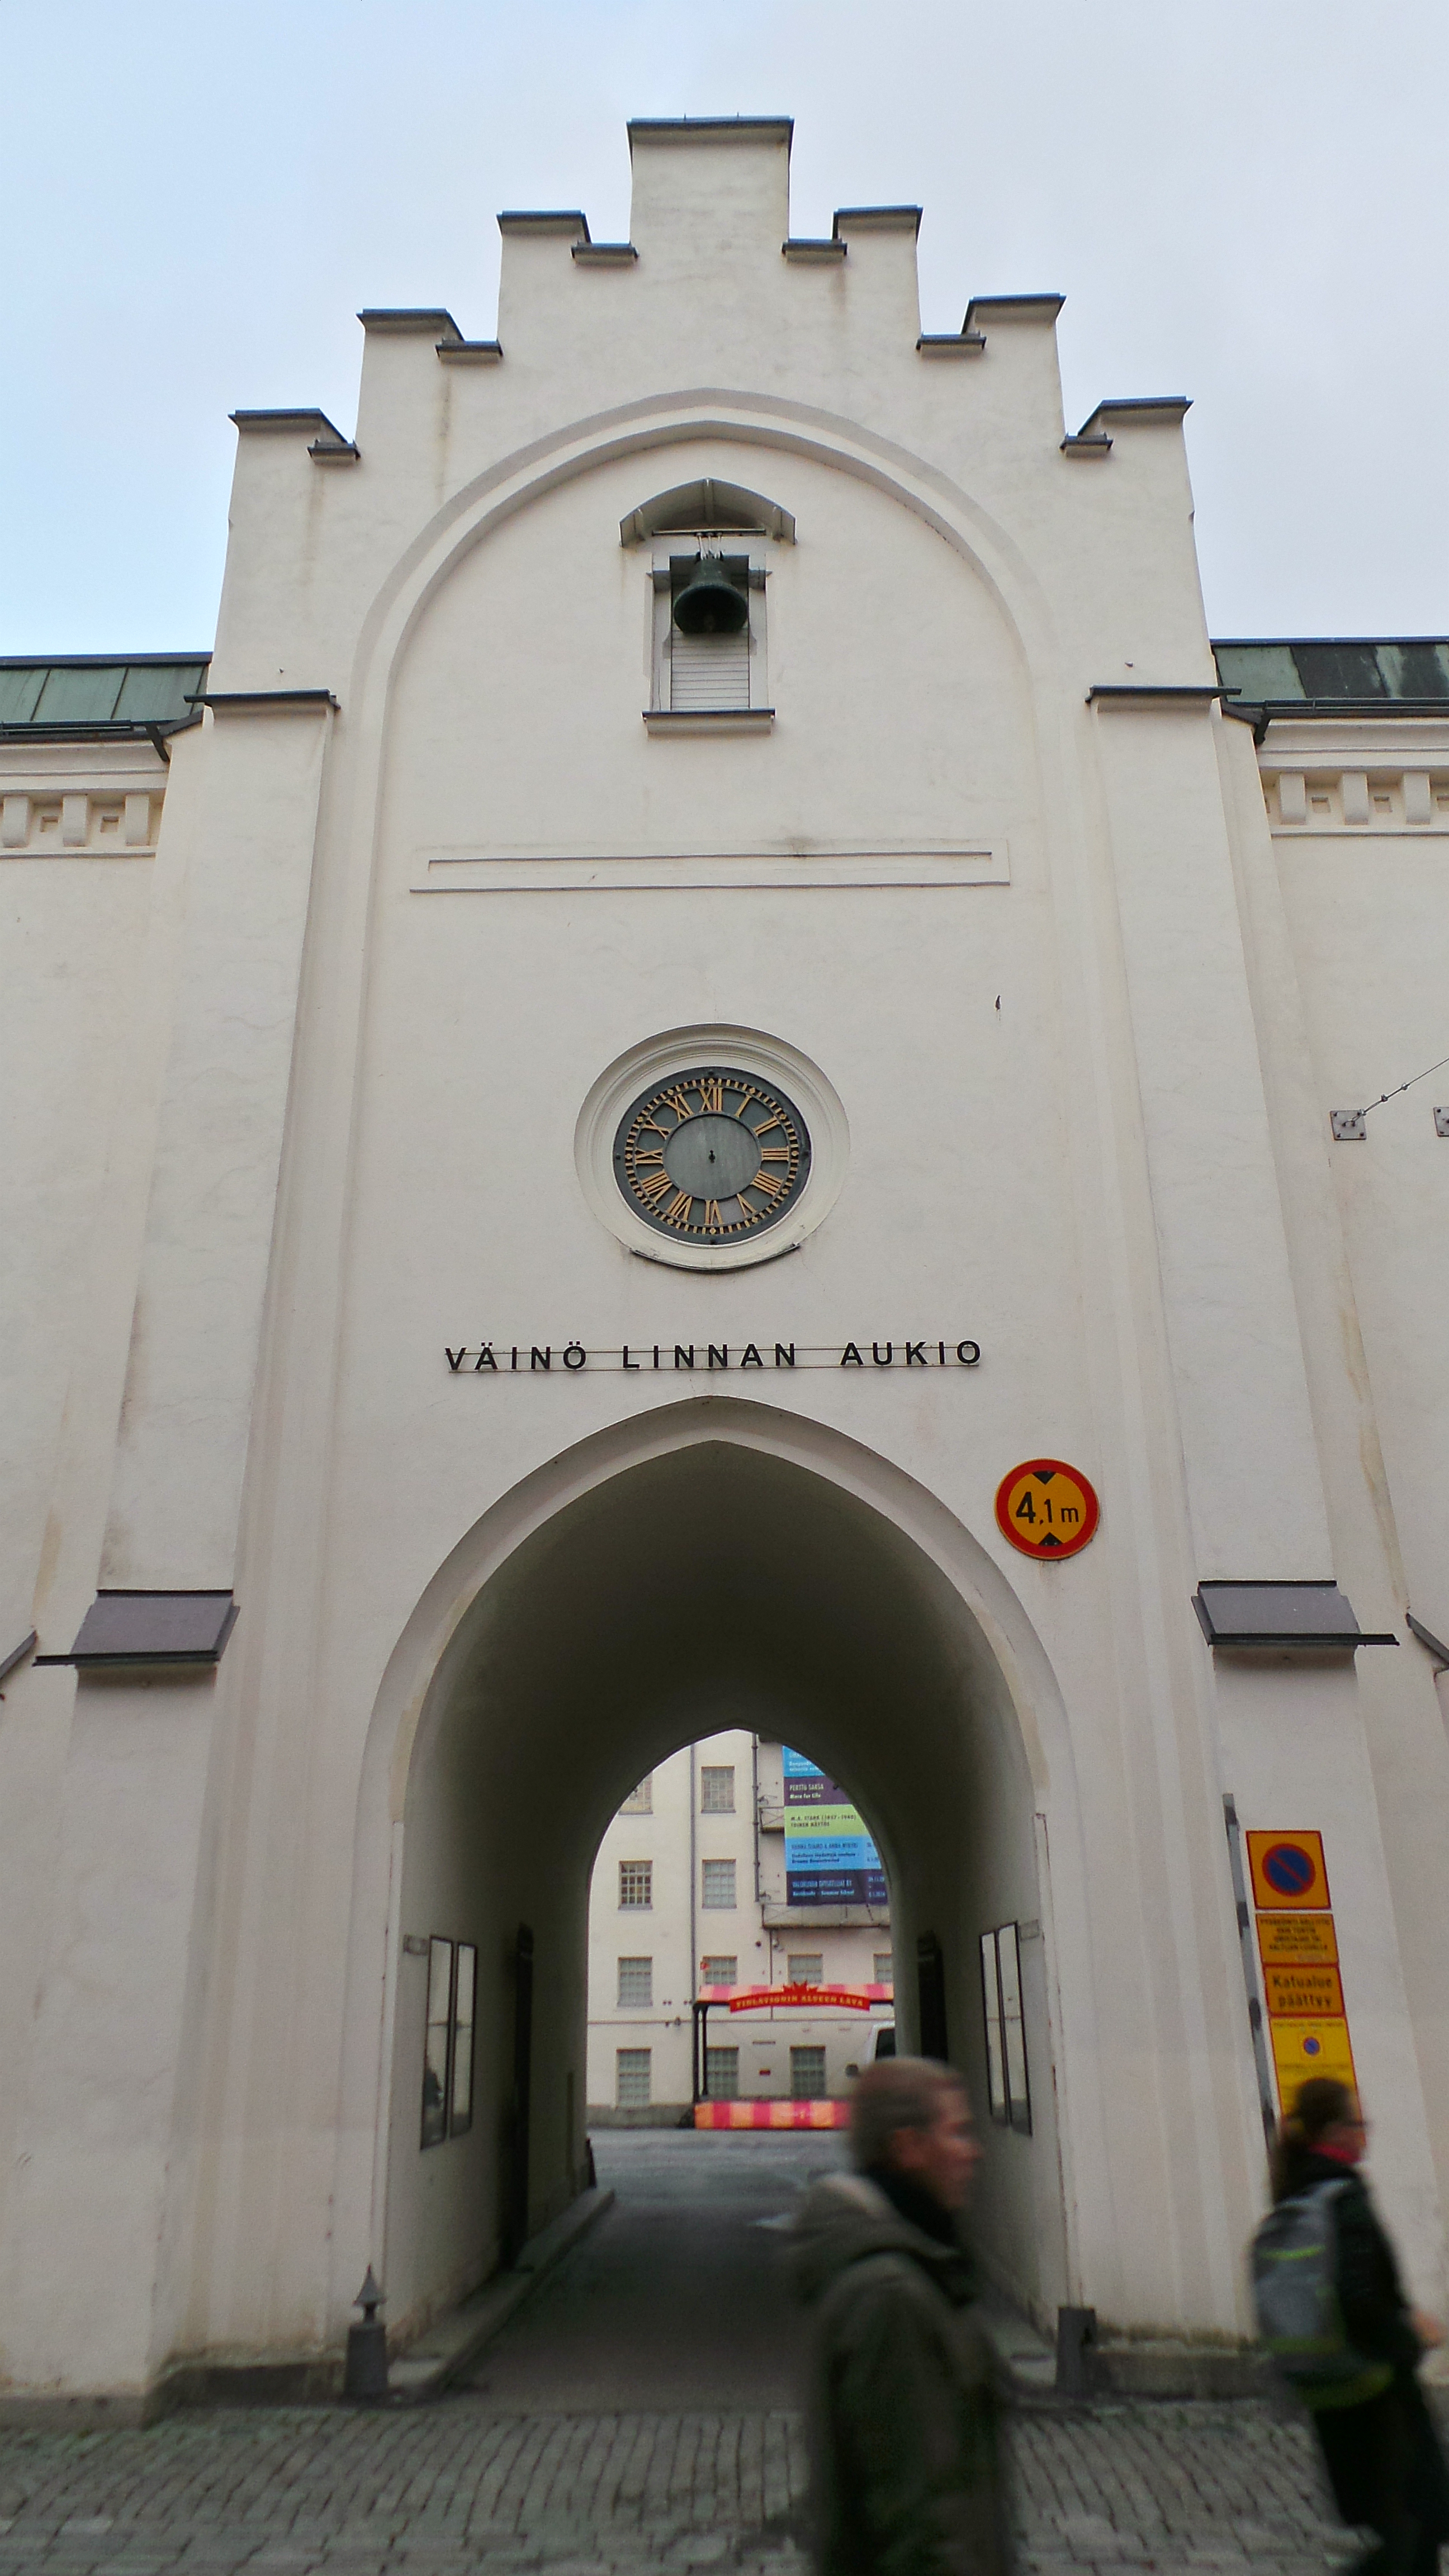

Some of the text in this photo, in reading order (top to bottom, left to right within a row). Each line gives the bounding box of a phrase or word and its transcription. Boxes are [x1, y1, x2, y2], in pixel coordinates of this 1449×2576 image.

[446, 1340, 981, 1371] VÄINÖ LINNAN AUKIO
[1016, 1491, 1079, 1525] 4,1 m
